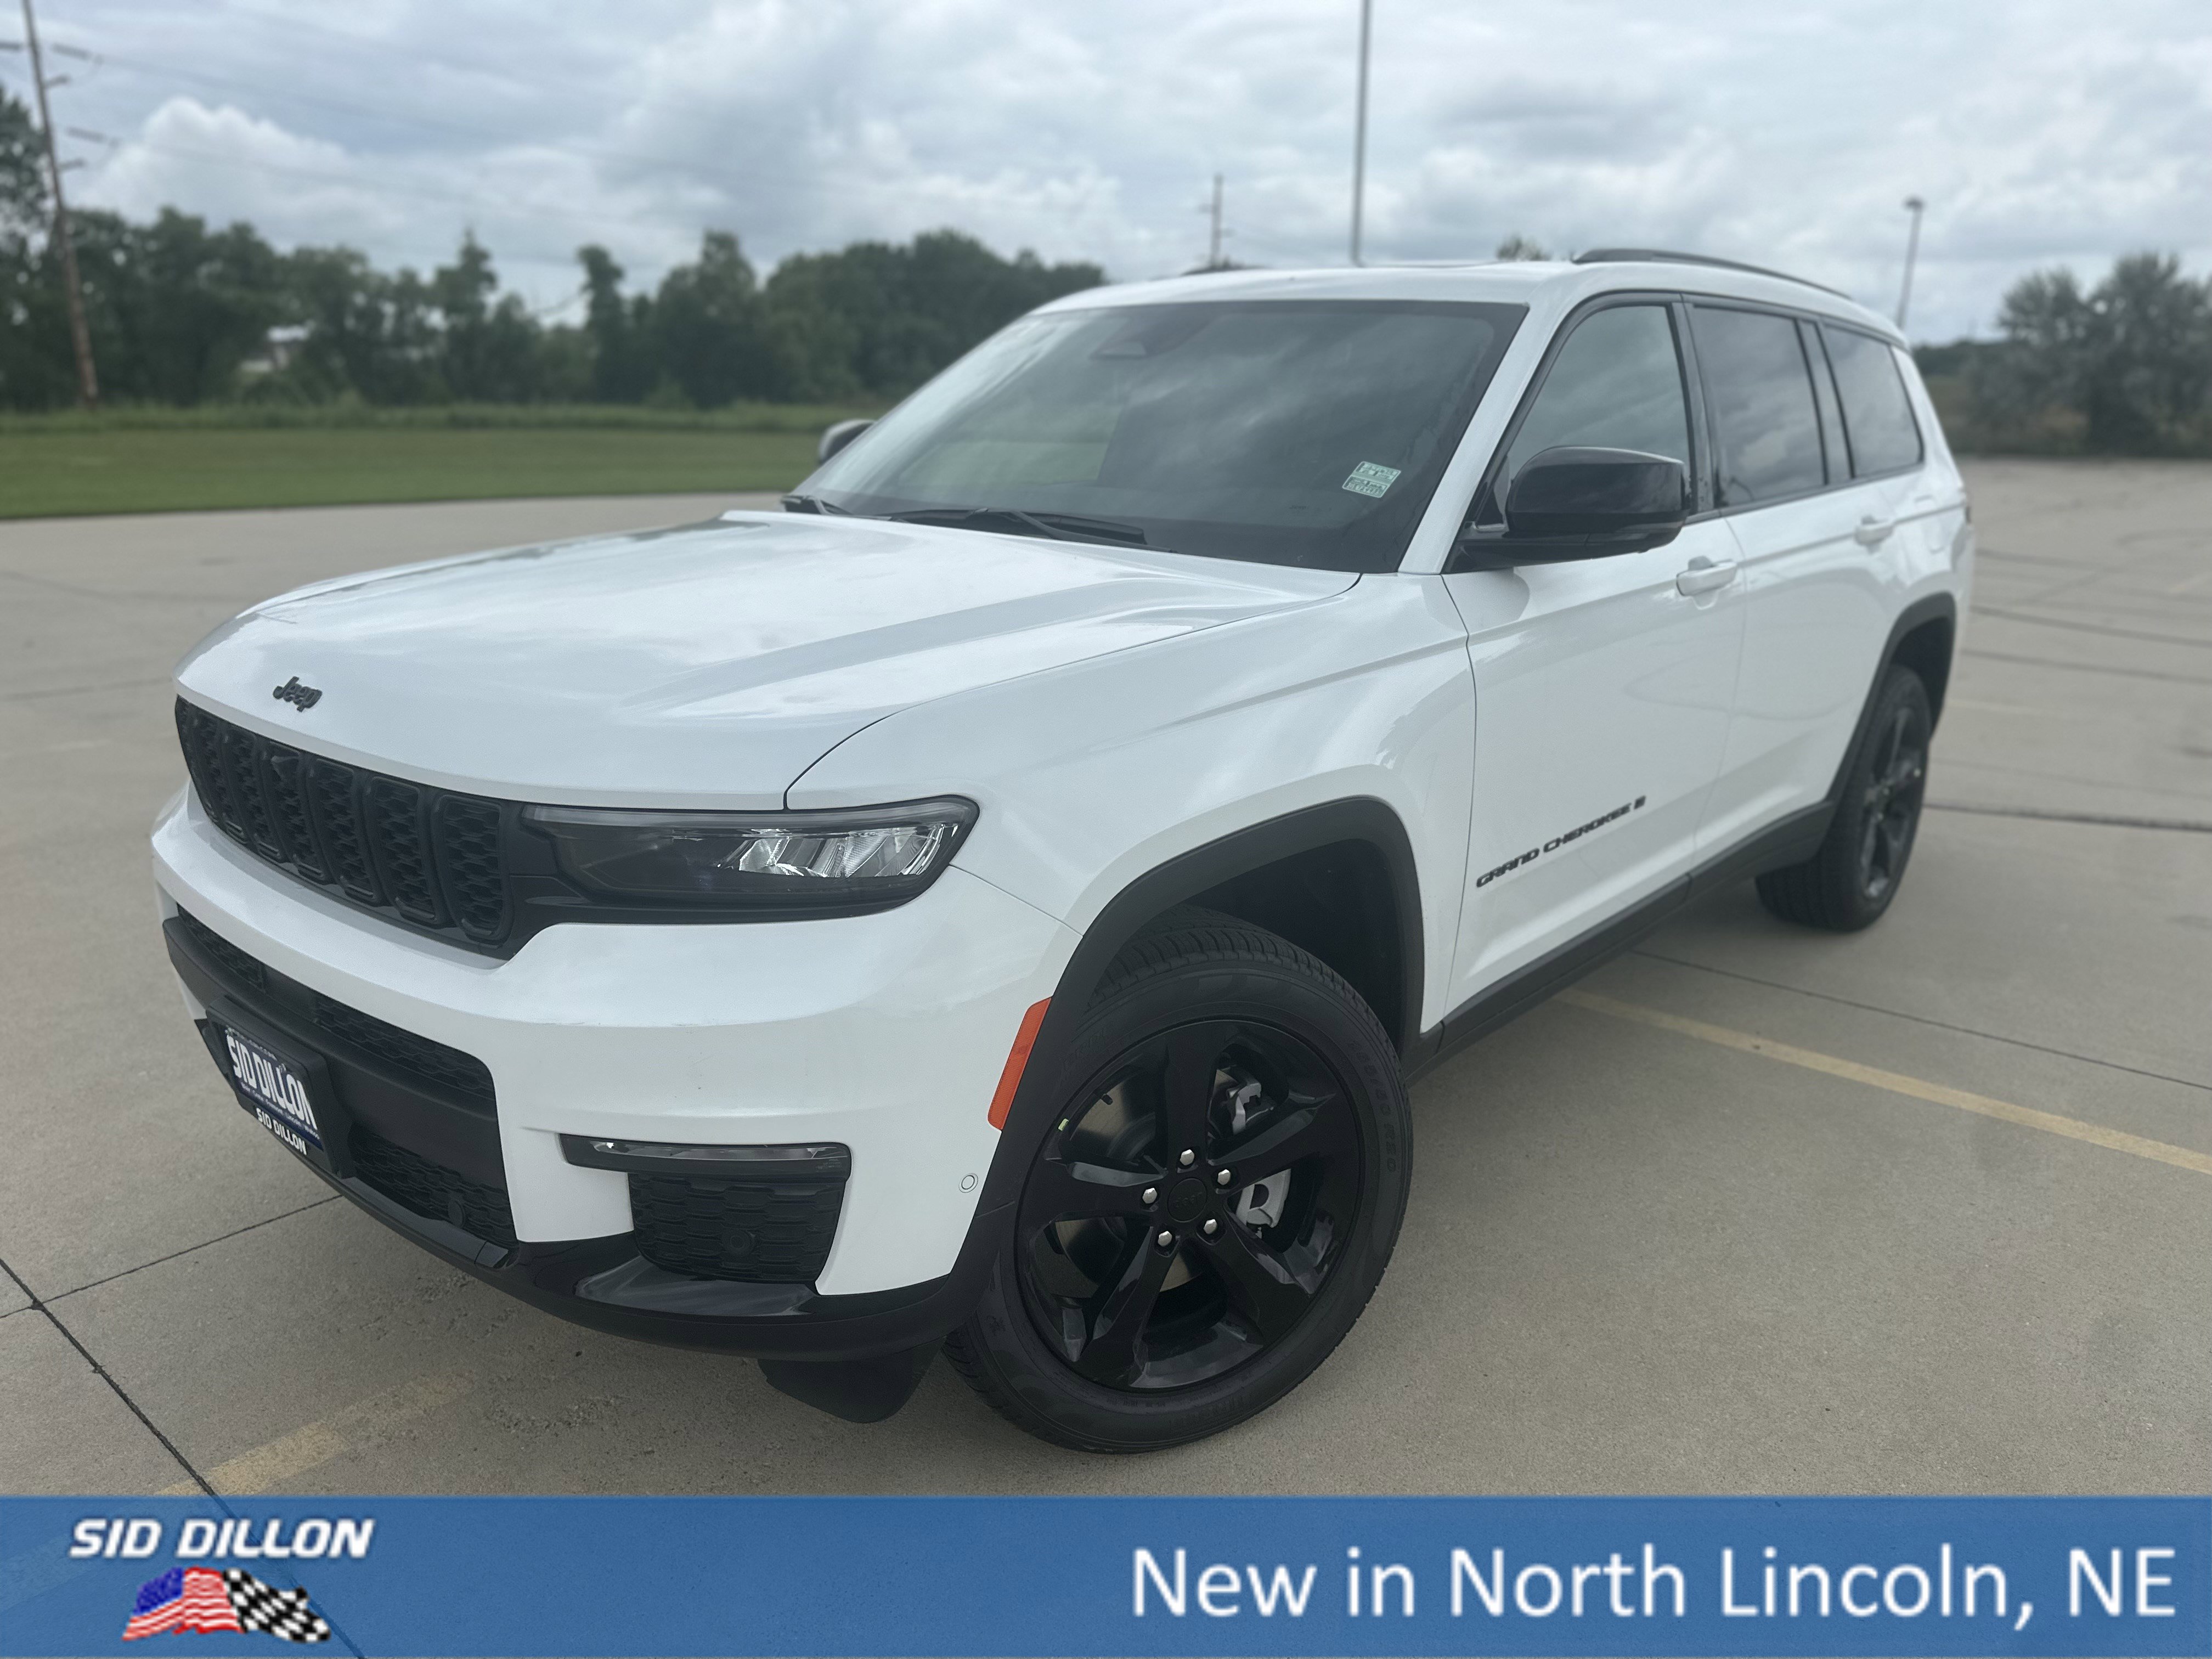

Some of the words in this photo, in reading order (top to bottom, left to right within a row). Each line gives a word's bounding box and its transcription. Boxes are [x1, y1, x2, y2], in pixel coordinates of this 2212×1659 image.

[273, 675, 323, 713] Jeep
[1476, 848, 1540, 888] GRAND
[1543, 802, 1632, 853] CHEROKEE
[226, 1035, 257, 1090] SID
[252, 1051, 318, 1131] DILLON
[256, 1108, 273, 1129] SID
[273, 1119, 307, 1155] DILLON
